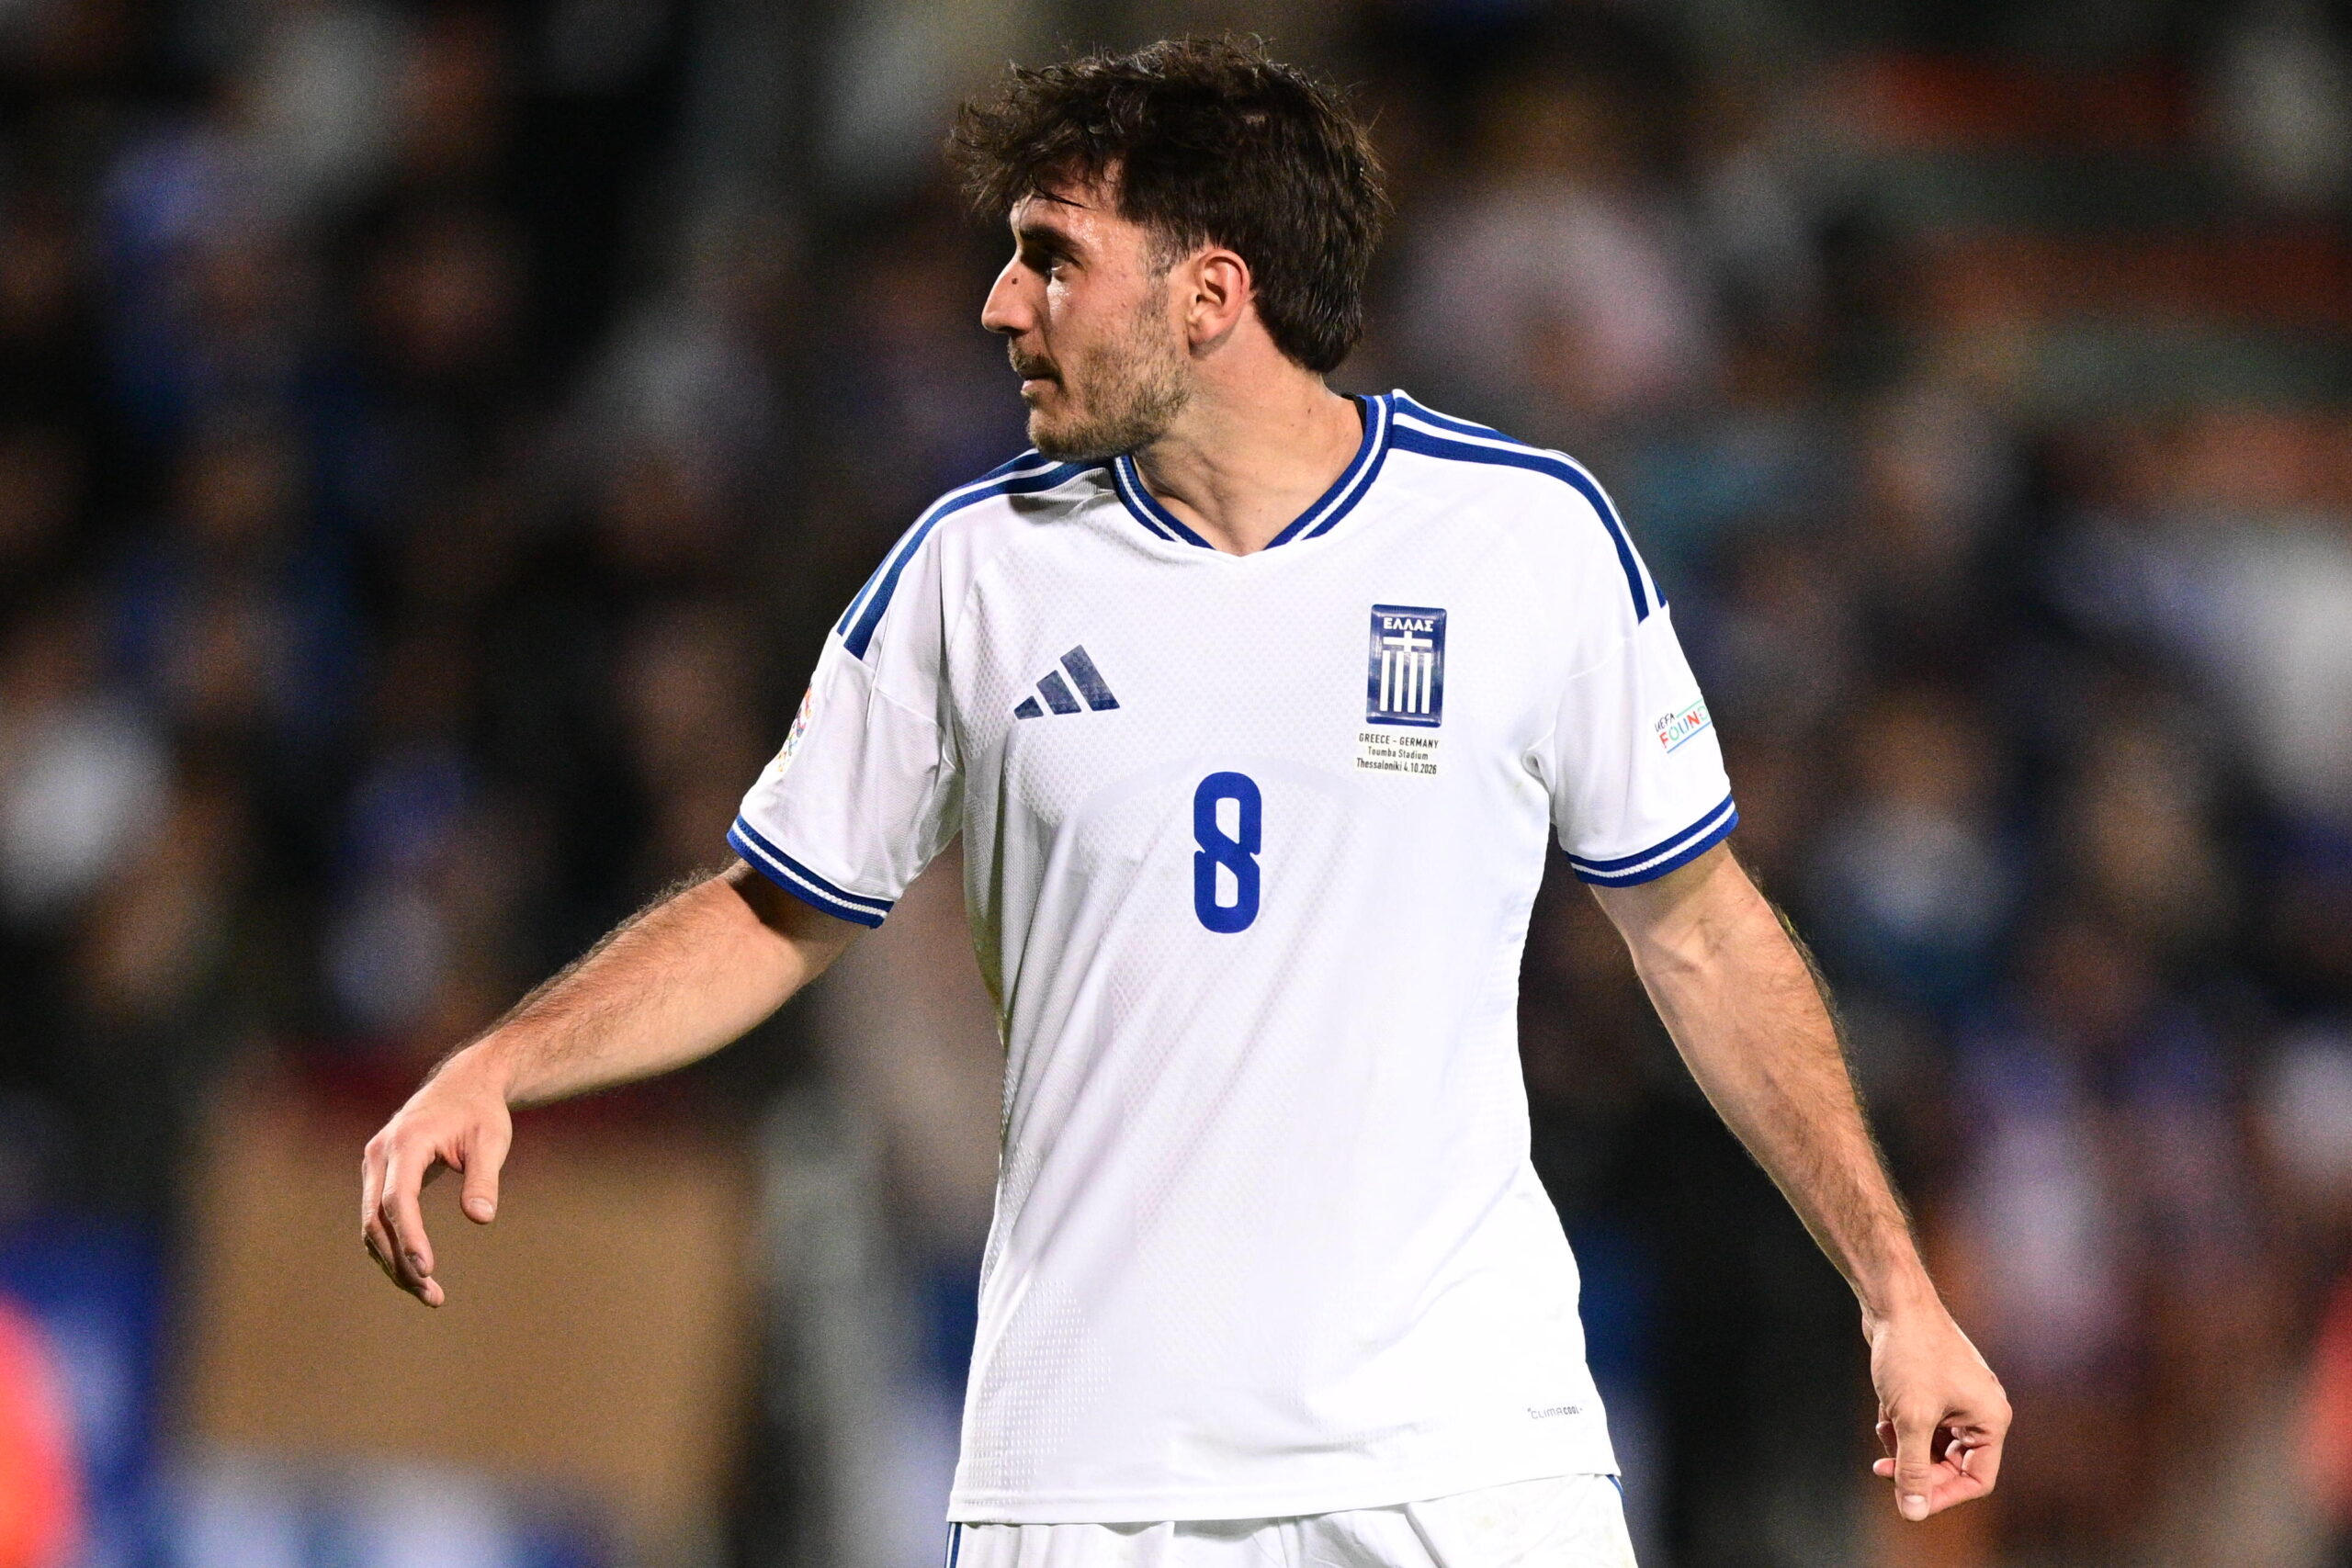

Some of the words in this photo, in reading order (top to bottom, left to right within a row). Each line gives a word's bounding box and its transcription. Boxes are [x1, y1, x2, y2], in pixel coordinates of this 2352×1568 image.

[1383, 617, 1434, 632] ΕΛΛΑΣ
[1655, 712, 1676, 732] UEFA
[1359, 733, 1390, 744] GREECE
[1399, 737, 1439, 749] GERMANY
[1368, 746, 1396, 758] Toumba
[1398, 749, 1429, 761] Stadium
[1357, 757, 1403, 772] Thessaloniki
[1404, 761, 1437, 774] 4.10.2026
[1193, 771, 1262, 934] 8
